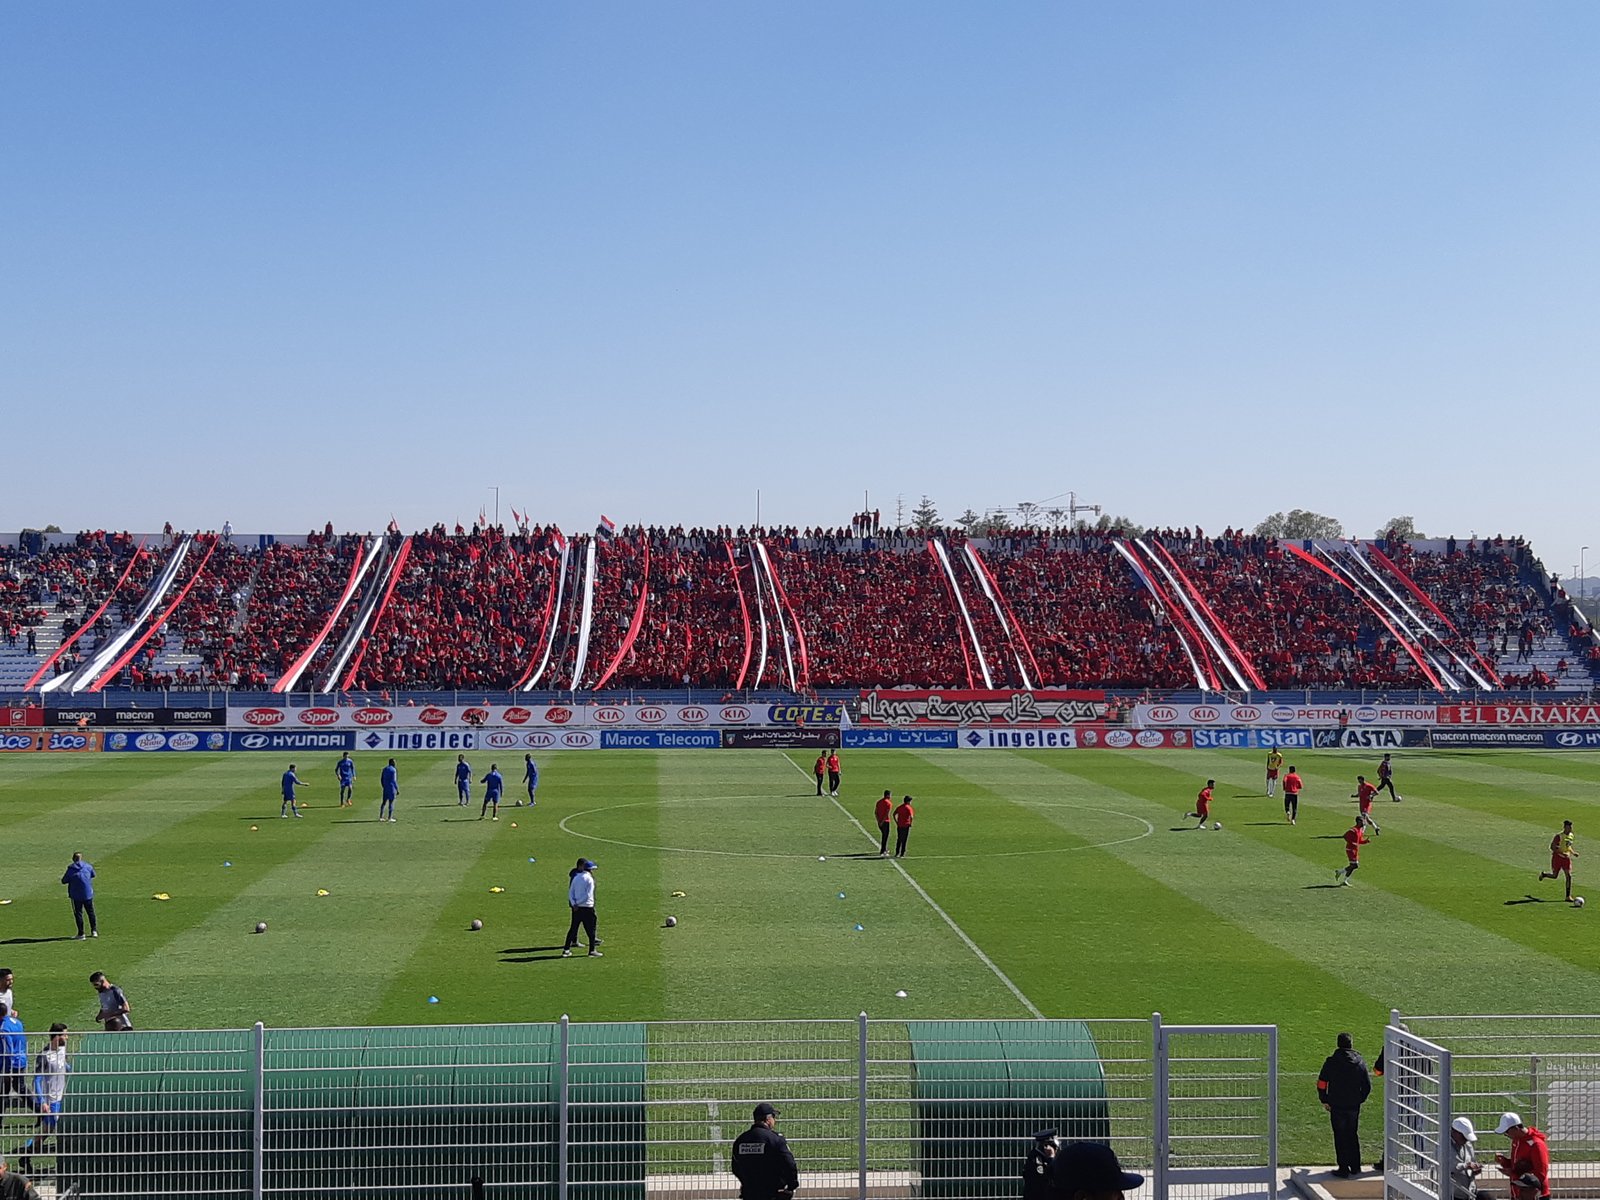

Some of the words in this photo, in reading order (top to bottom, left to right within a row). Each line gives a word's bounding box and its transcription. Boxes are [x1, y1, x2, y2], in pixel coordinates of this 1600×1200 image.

[598, 711, 620, 720] KIA
[640, 710, 662, 719] KIA
[682, 710, 704, 719] KIA
[724, 709, 746, 718] KIA
[1152, 709, 1173, 718] KIA
[1194, 709, 1215, 718] KIA
[1236, 709, 1257, 718] KIA
[1380, 709, 1435, 719] PETROM
[1458, 706, 1487, 723] EL
[1495, 706, 1600, 723] BARAKA
[273, 735, 346, 746] HYUNDAI
[388, 731, 473, 749] ingelec
[490, 735, 513, 744] KIA
[528, 735, 551, 744] KIA
[566, 735, 588, 743] KIA
[605, 732, 650, 746] Maroc
[656, 732, 715, 746] Telecom
[845, 732, 893, 746] المغرب
[899, 732, 952, 743] اتصالات
[989, 730, 1070, 747] ingelec
[1195, 730, 1244, 746] Star
[1261, 730, 1309, 746] Star
[1346, 730, 1399, 747] ASTA
